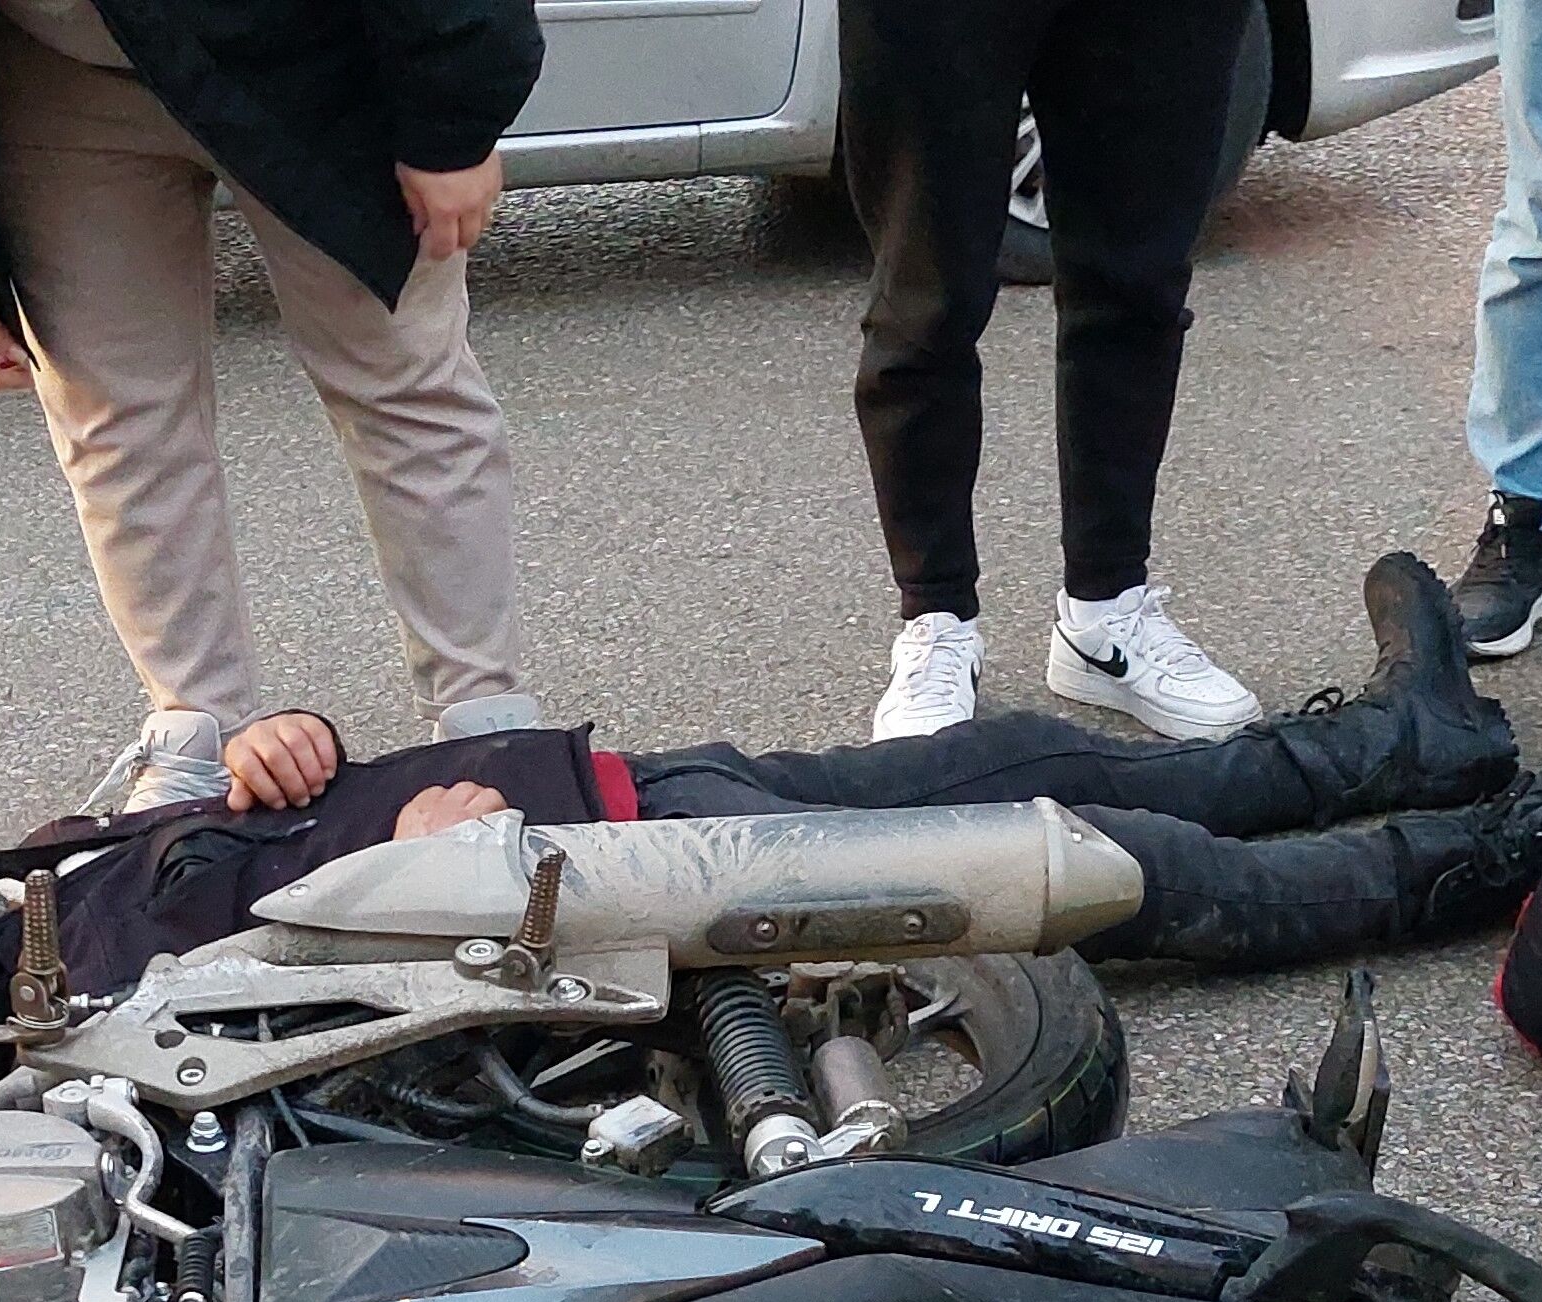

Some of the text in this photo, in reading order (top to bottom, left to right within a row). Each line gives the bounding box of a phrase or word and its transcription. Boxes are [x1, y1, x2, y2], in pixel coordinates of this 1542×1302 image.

[912, 1191, 1165, 1257] 125 DRIFT L
